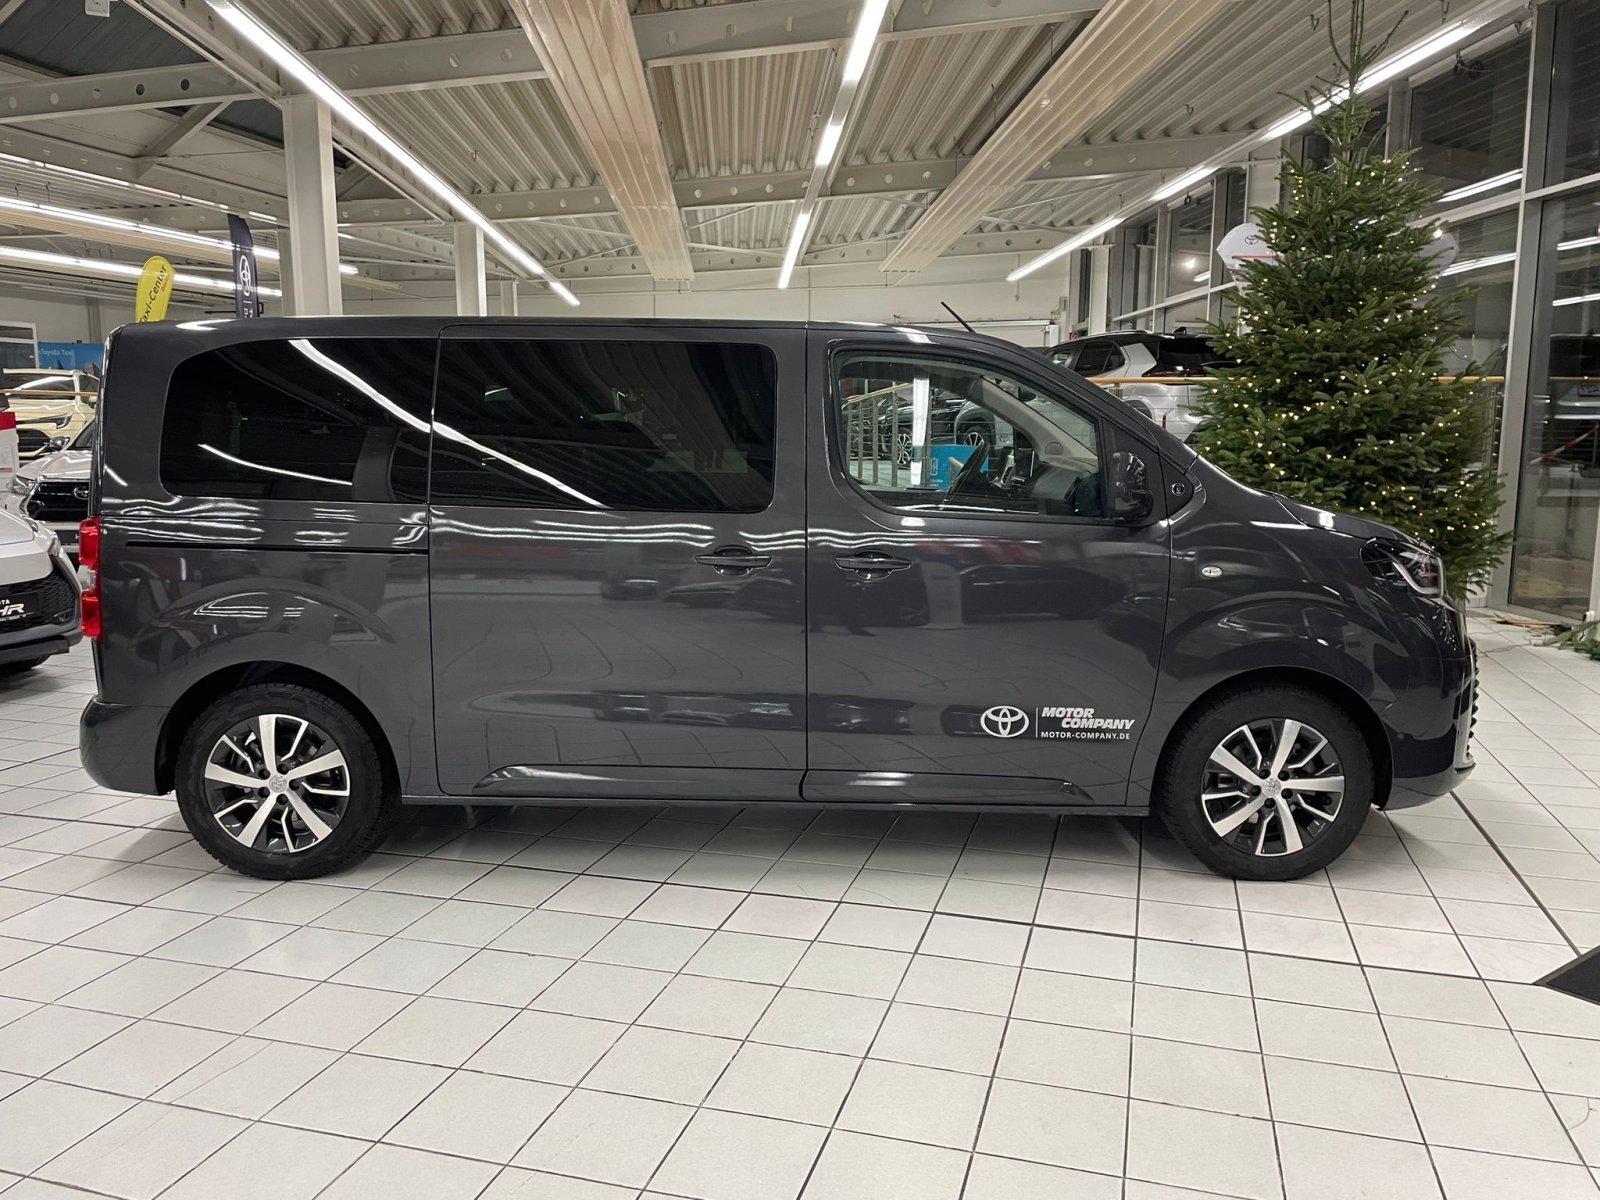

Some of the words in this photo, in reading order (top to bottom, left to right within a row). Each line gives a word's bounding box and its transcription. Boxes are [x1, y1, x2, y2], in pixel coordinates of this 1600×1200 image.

[1041, 707, 1095, 718] MOTOR
[1061, 718, 1135, 730] COMPANY
[1041, 731, 1130, 740] MOTOR-COMPANY.DE
